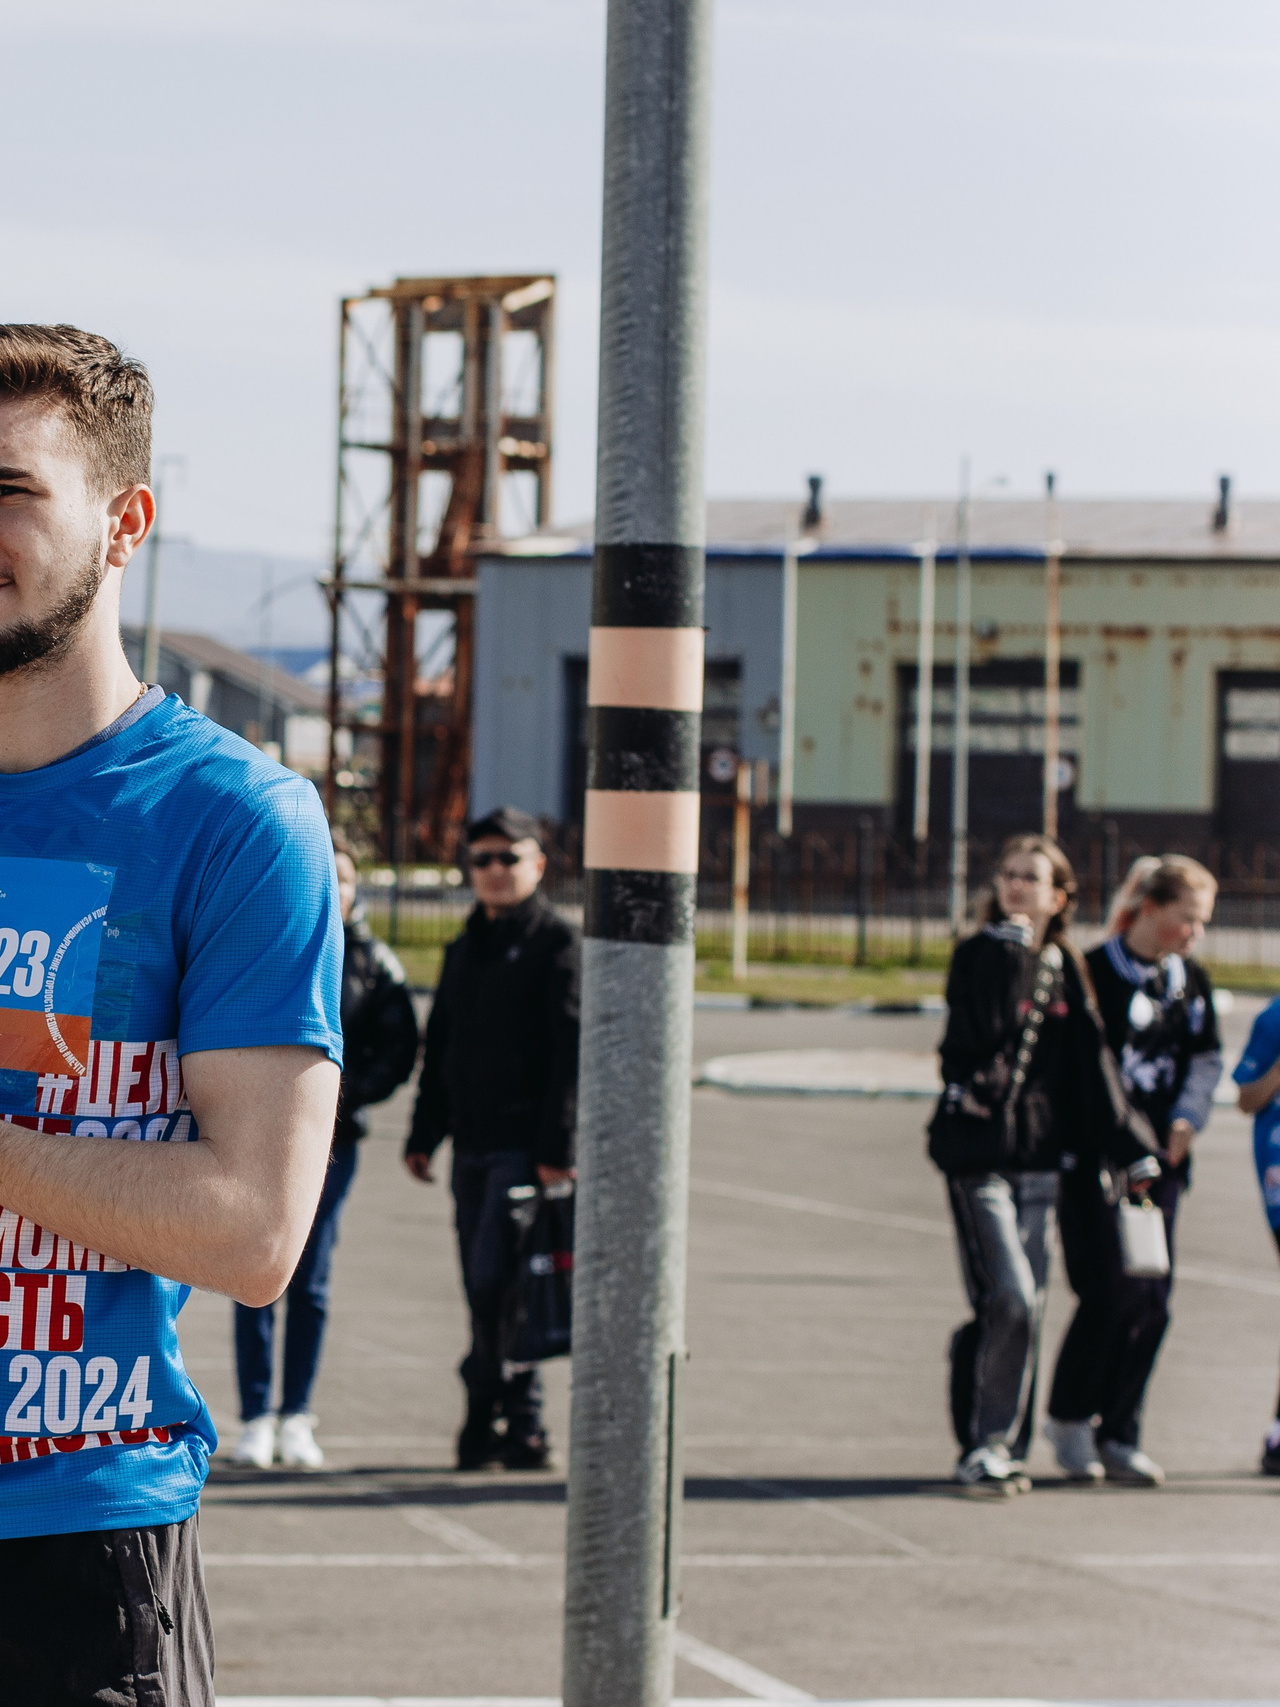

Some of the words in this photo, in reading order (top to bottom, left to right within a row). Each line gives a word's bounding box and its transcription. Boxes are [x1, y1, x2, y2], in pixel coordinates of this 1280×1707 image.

[49, 913, 93, 973] #САМОВЫРАЖЕНИЕ
[44, 972, 56, 1013] #ГОРДОСТЬ
[45, 1012, 68, 1053] #ЕДИНСТВО
[36, 1039, 190, 1117] #ЦЕЛ
[62, 1051, 86, 1076] #МЕЧТА
[5, 1355, 153, 1434] 2024
